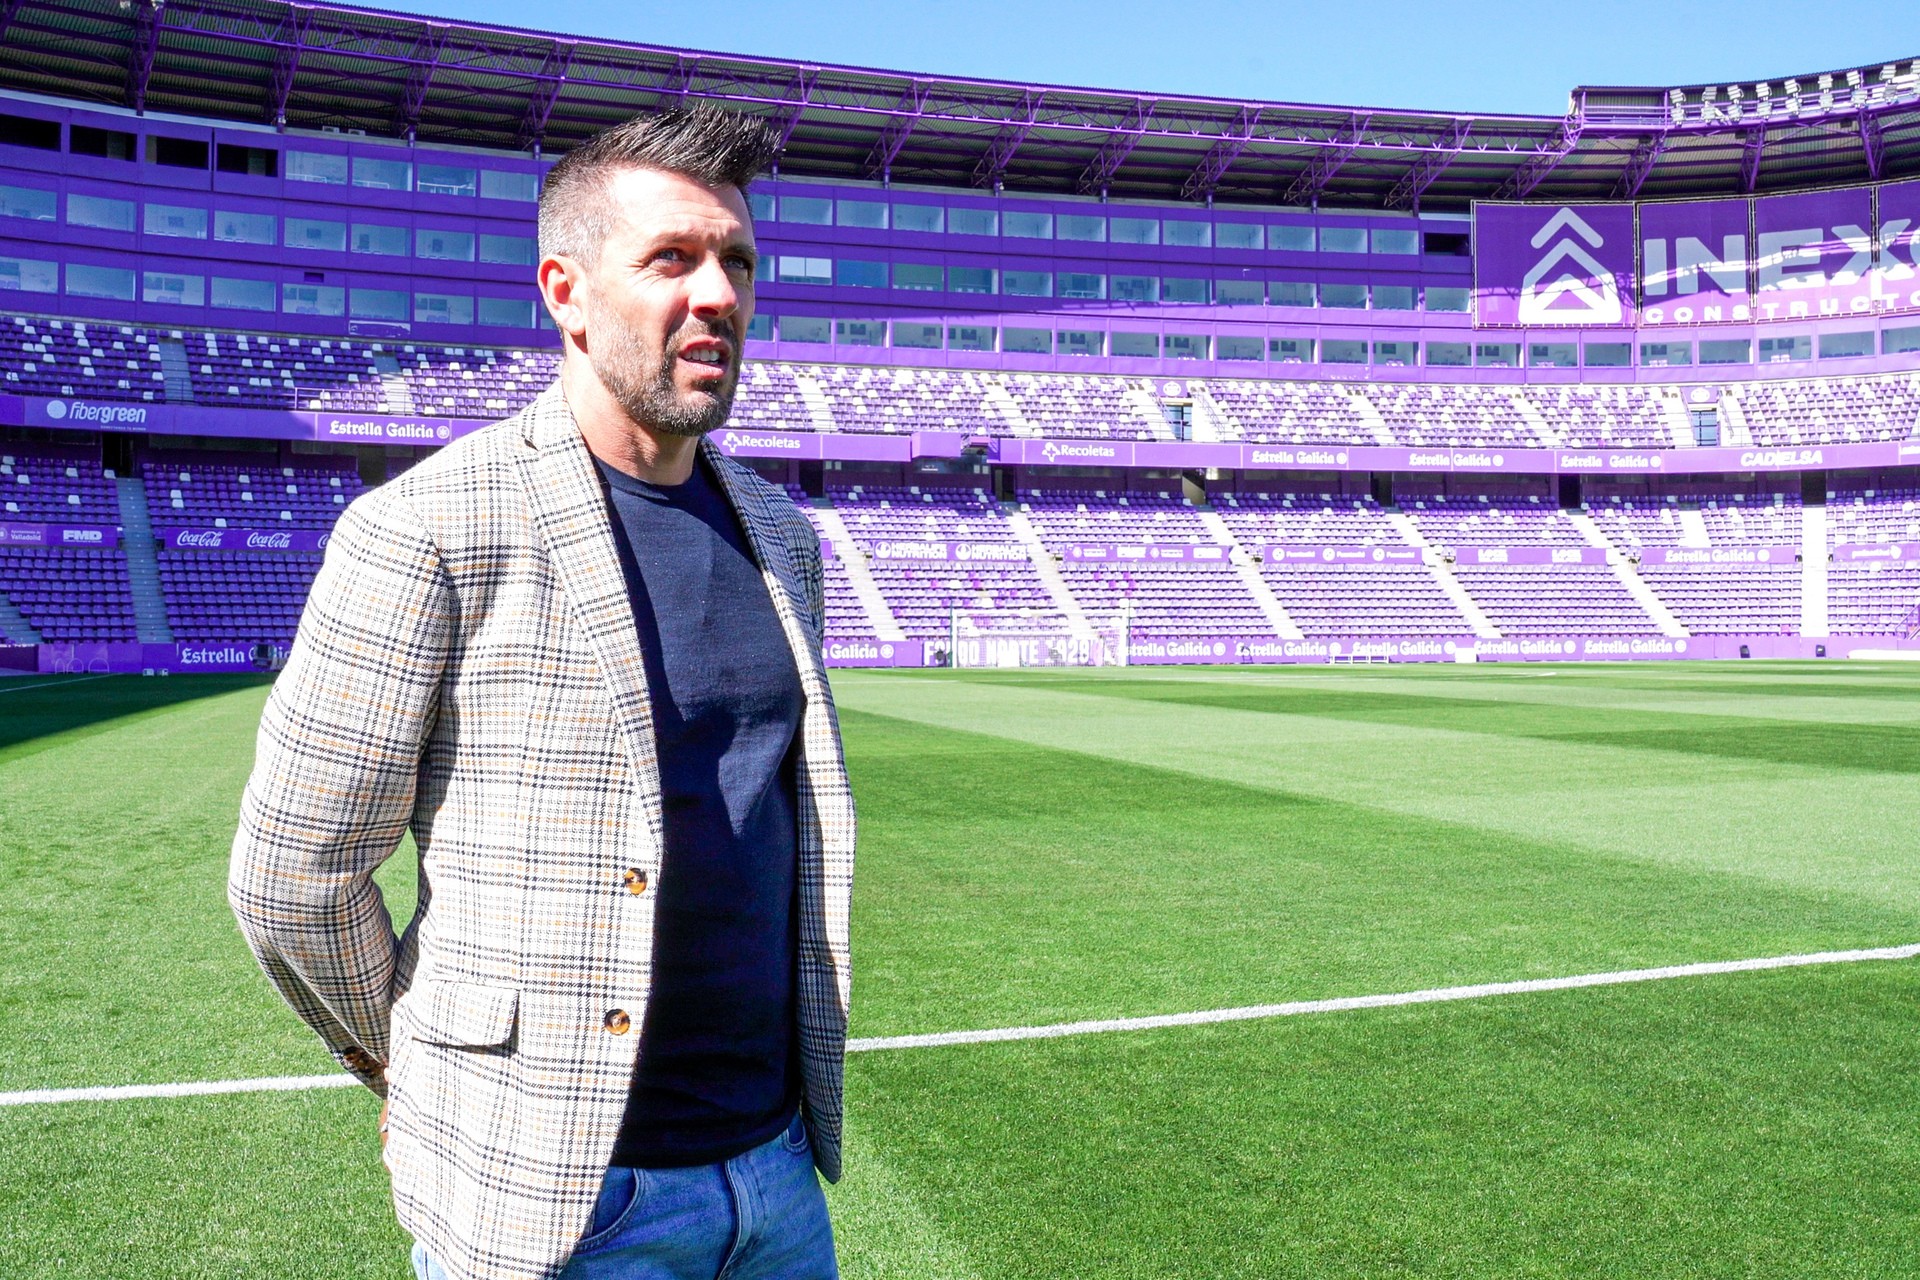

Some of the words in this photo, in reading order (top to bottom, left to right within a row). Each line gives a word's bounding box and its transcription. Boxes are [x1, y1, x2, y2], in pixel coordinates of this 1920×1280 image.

[1643, 219, 1920, 296] INEX
[69, 402, 147, 424] fibergreen
[329, 420, 382, 436] Estrella
[386, 423, 434, 438] Galicia
[742, 435, 801, 449] Recoletas
[1061, 444, 1115, 457] Recoletas
[1252, 450, 1294, 463] Estrella
[1296, 451, 1335, 464] Galicia
[1409, 453, 1450, 466] Estrella
[1453, 453, 1491, 466] Galicia
[1561, 455, 1603, 468] Estrella
[1609, 455, 1649, 468] Galicia
[63, 530, 103, 540] FMD
[829, 643, 878, 659] Galicia
[924, 640, 980, 665] FDO
[1118, 643, 1165, 656] strella
[1166, 641, 1211, 656] Galicia
[1284, 641, 1327, 656] Galicia
[1400, 641, 1442, 656] Galicia
[1520, 640, 1562, 654] Galicia
[1584, 640, 1630, 653] Estrella
[1630, 639, 1673, 653] Galicia
[180, 647, 246, 664] Estrella
